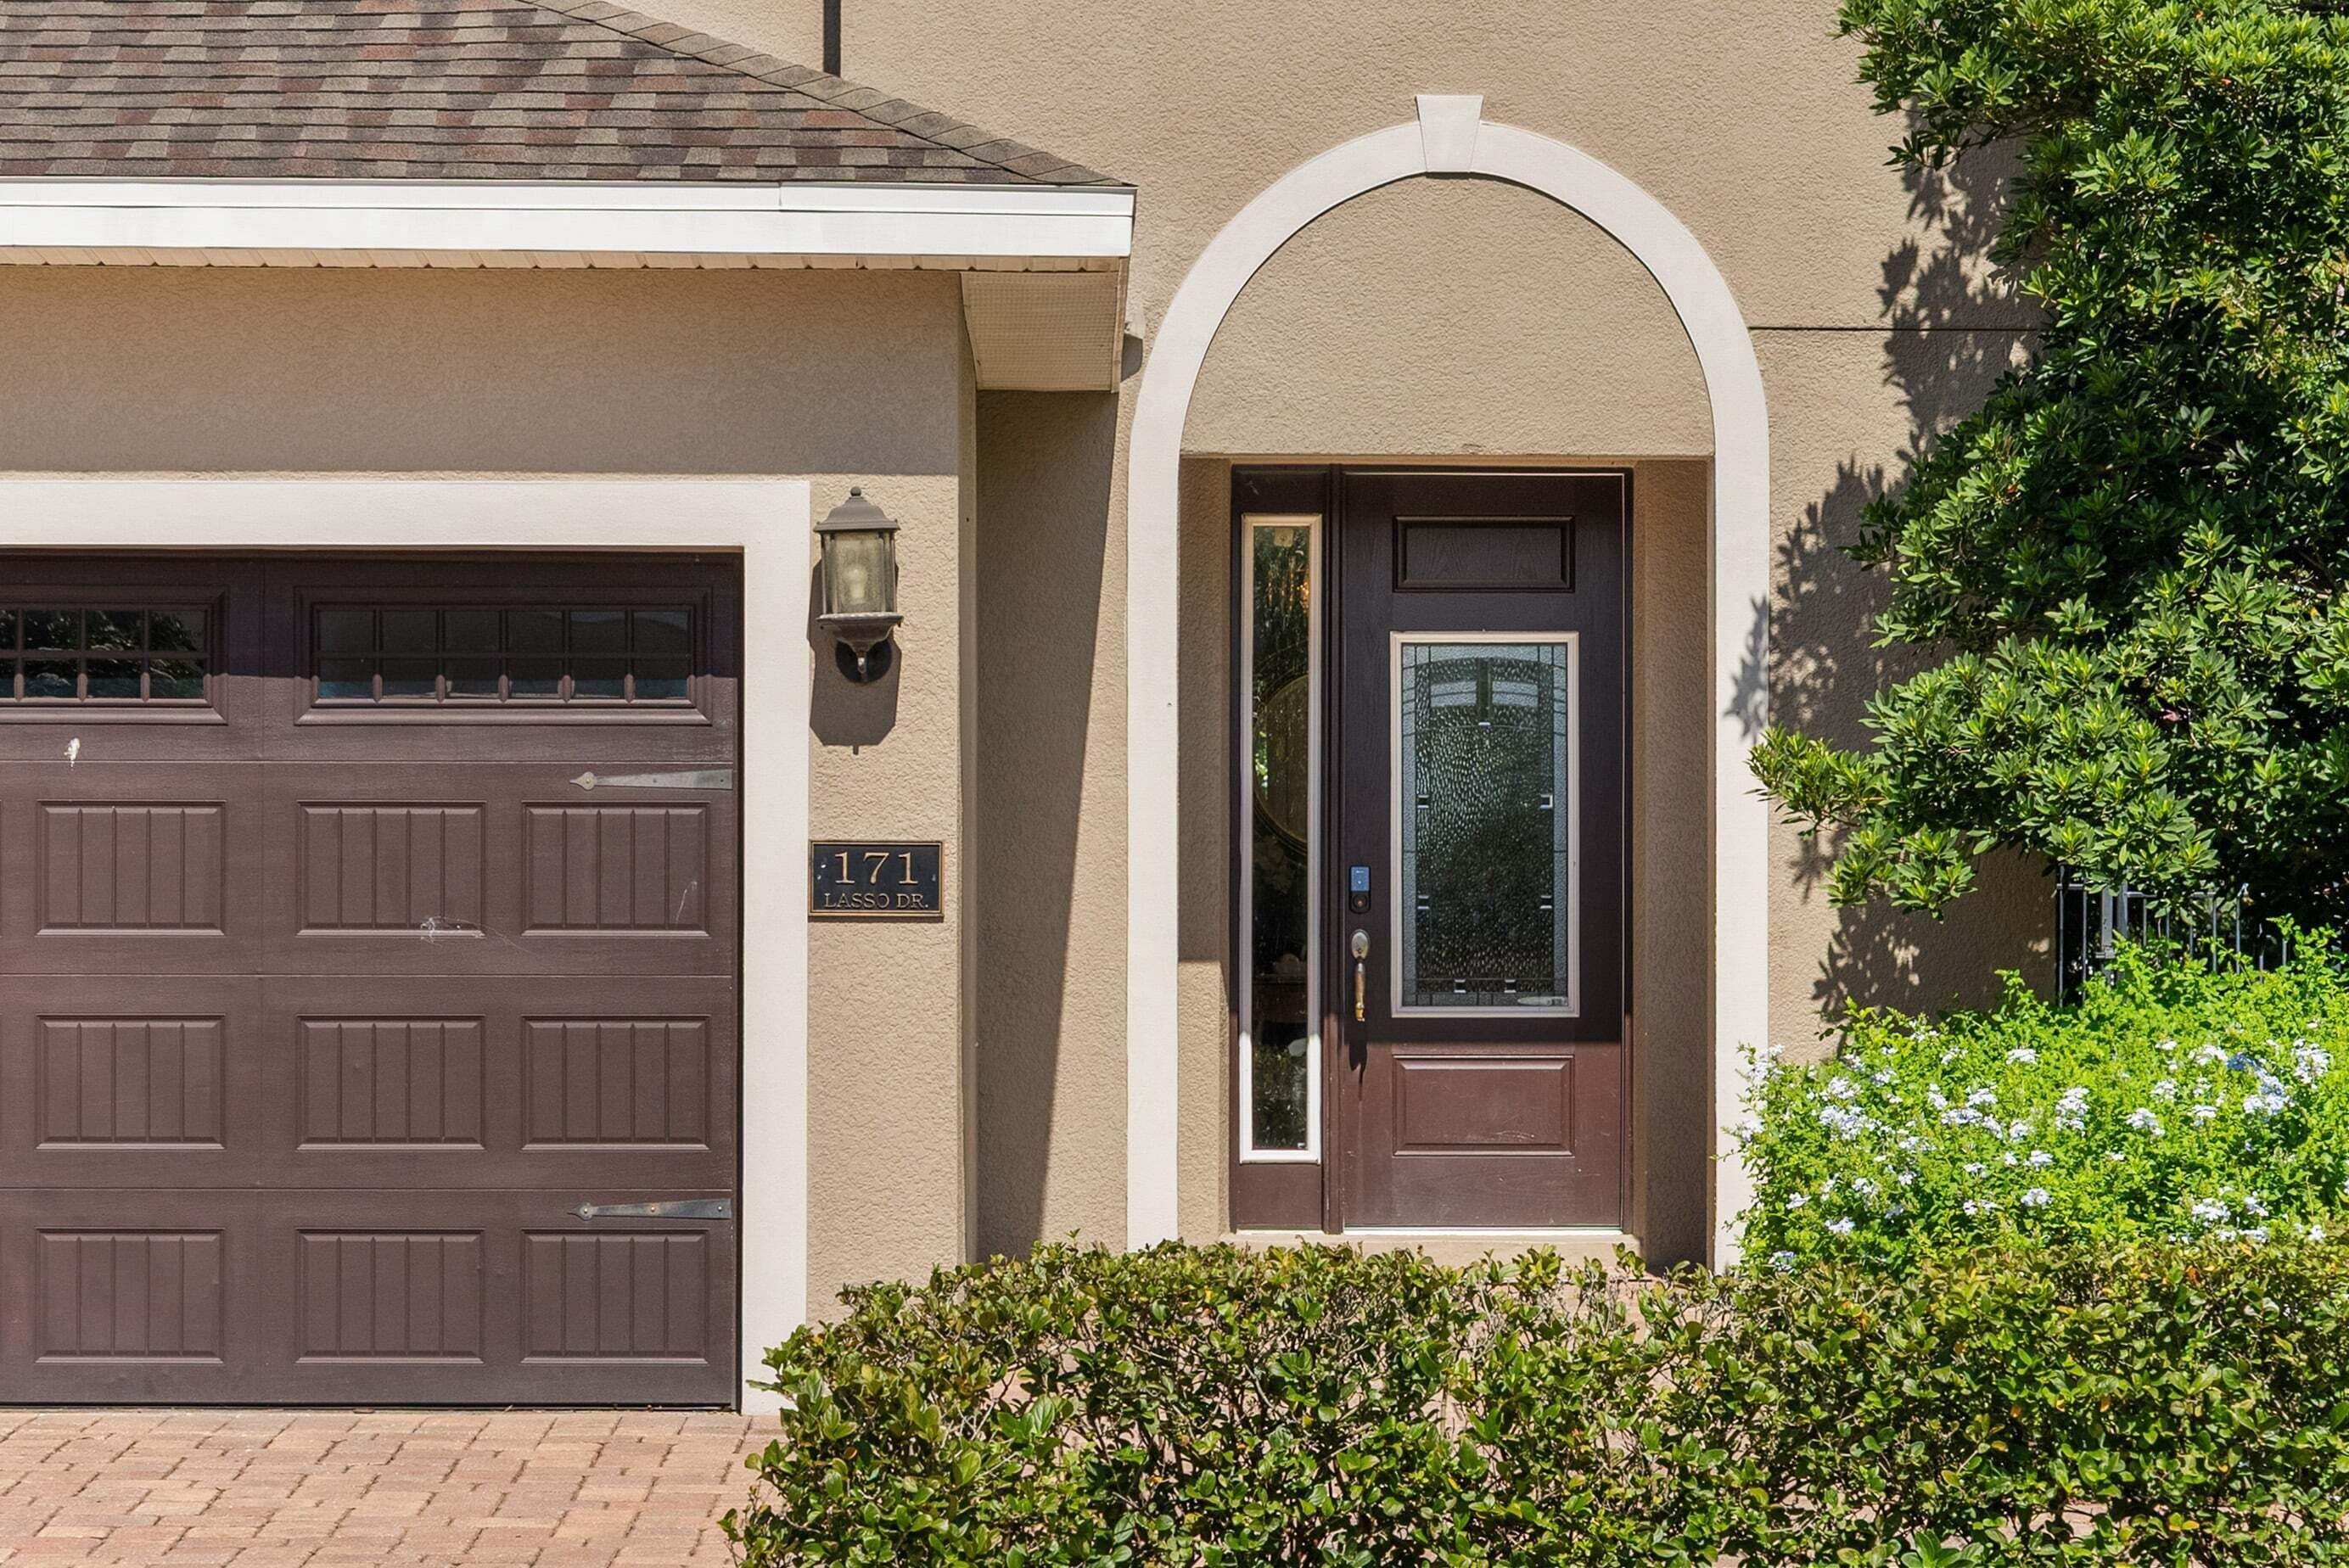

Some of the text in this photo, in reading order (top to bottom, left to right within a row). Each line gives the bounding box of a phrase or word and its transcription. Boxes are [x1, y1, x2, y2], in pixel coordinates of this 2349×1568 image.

[834, 851, 919, 884] 171
[823, 893, 929, 909] LASSO DR.
